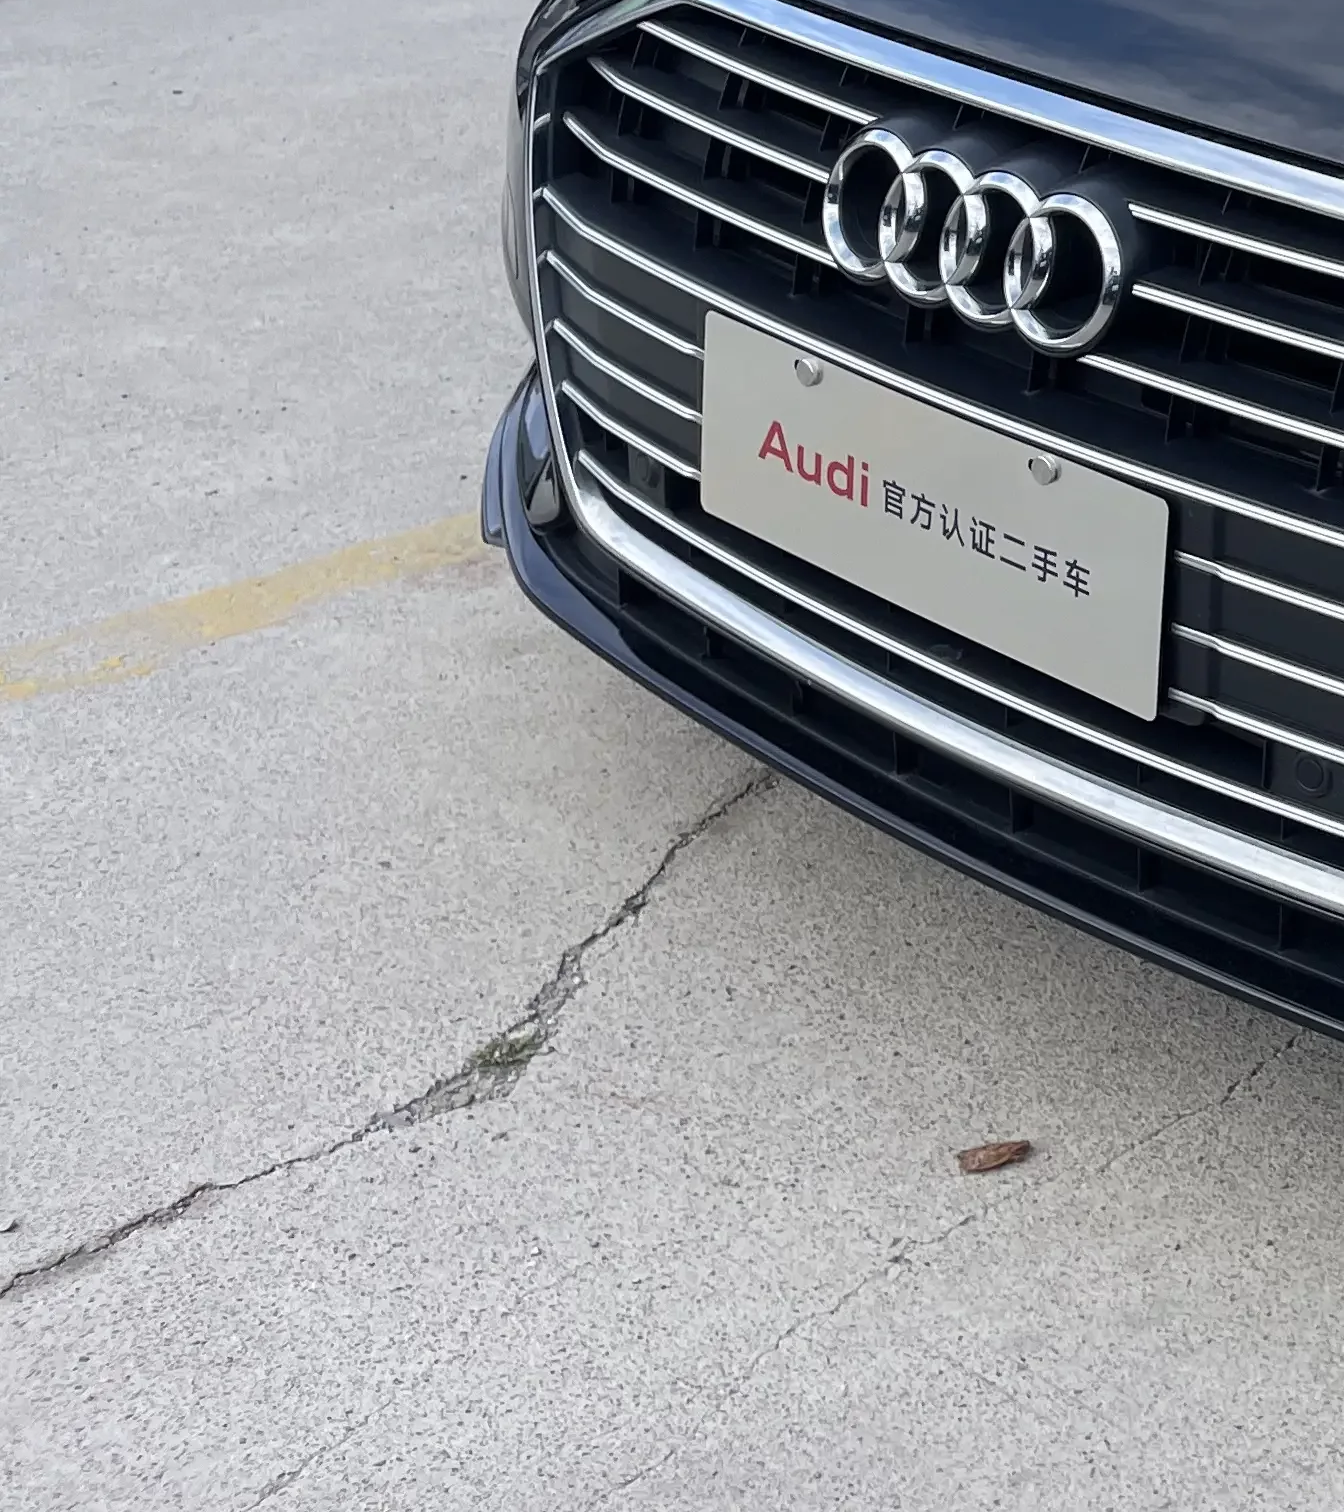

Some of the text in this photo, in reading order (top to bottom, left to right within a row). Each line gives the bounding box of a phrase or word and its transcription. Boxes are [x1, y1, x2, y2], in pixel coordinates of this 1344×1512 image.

[757, 419, 1091, 598] Audi 官方认证二手车
